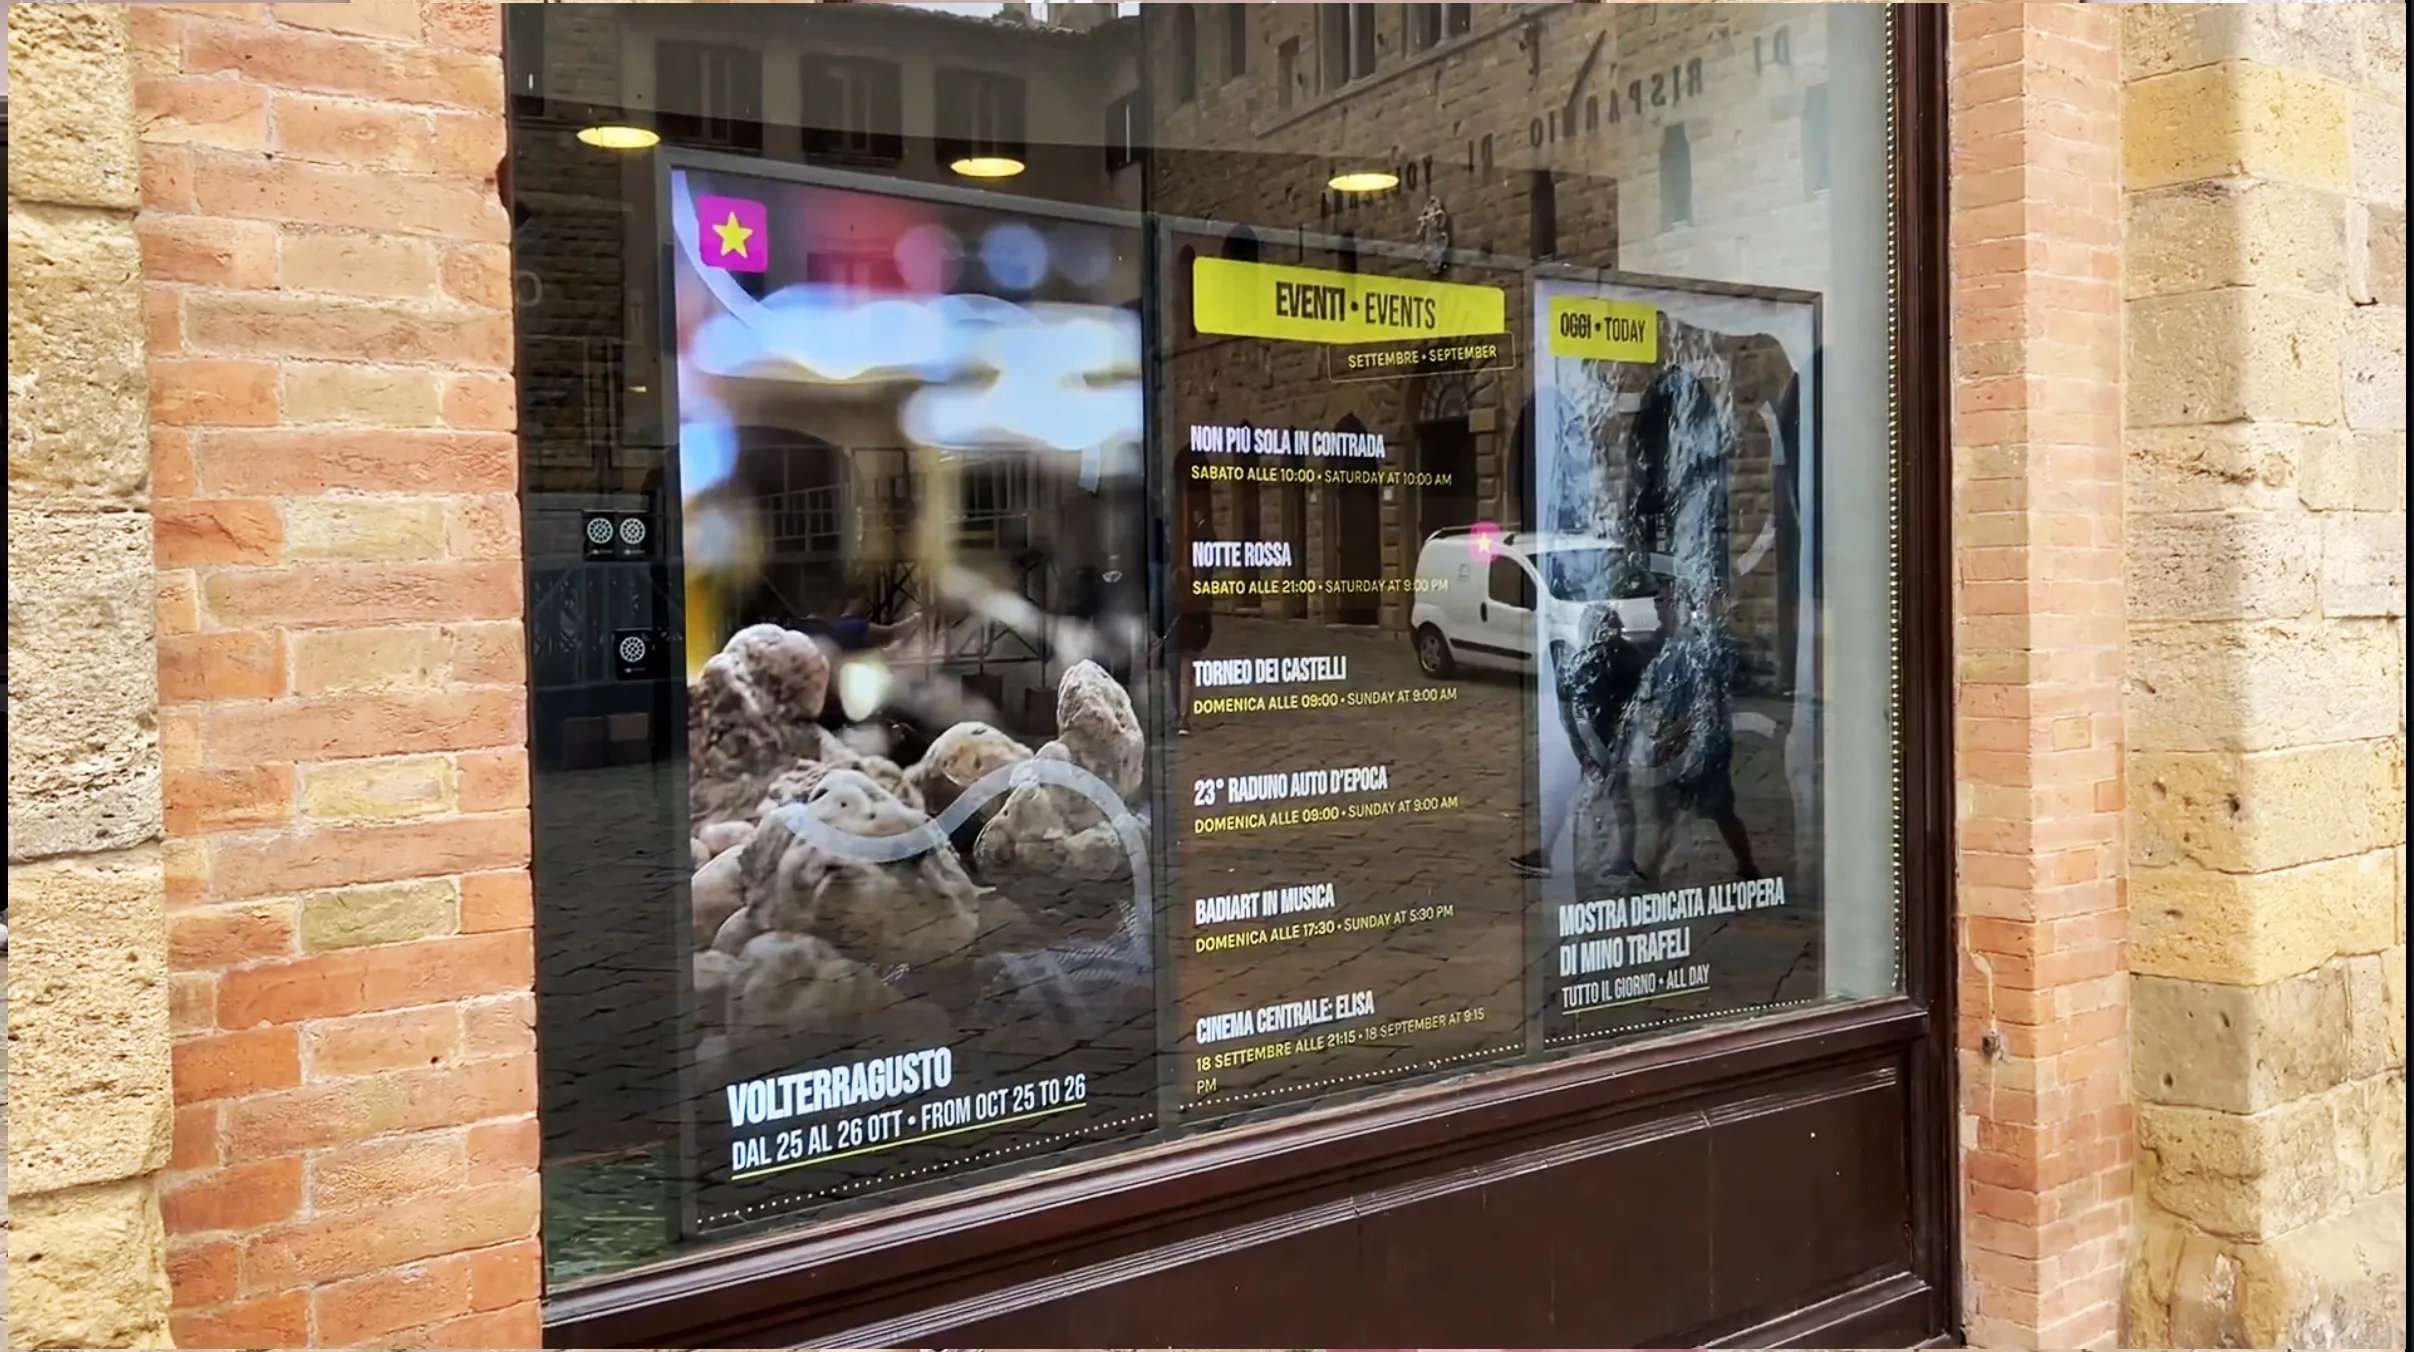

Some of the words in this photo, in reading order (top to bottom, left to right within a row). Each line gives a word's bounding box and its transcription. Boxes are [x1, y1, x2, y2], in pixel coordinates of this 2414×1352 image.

[1276, 281, 1346, 322] EVENTI
[1365, 292, 1436, 329] EVENTS
[1560, 312, 1591, 338] OGGI
[1604, 317, 1646, 344] TODAY
[1348, 351, 1419, 369] SETTEMBRE
[1429, 345, 1497, 362] SEPTEMBER
[1191, 426, 1224, 452] NON
[1226, 426, 1250, 453] PIÙ
[1253, 429, 1291, 454] SOLA
[1294, 431, 1309, 455] IN
[1312, 431, 1385, 458] CONTRADA
[1191, 466, 1244, 481] SABATO
[1247, 468, 1278, 482] ALLE
[1280, 468, 1315, 482] 10:00
[1324, 469, 1385, 484] SATURDAY
[1386, 472, 1401, 485] AT
[1403, 472, 1432, 486] 10:00
[1434, 473, 1452, 486] AM
[1192, 541, 1242, 568] NOTTE
[1244, 542, 1292, 567] ROSSA
[1192, 581, 1245, 595] SABATO
[1249, 580, 1279, 594] ALLE
[1282, 580, 1316, 594] 21:00
[1325, 579, 1387, 593] SATURDAY
[1388, 579, 1402, 592] AT
[1403, 579, 1429, 592] 9:00
[1432, 579, 1448, 592] PM
[1192, 659, 1252, 687] TORNEO
[1255, 659, 1279, 684] DEI
[1282, 656, 1346, 682] CASTELLI
[1194, 697, 1266, 714] DOMENICA
[1268, 695, 1298, 710] ALLE
[1301, 693, 1338, 708] 09:00
[1347, 691, 1395, 706] SUNDAY
[1398, 690, 1410, 703] AT
[1412, 689, 1437, 702] 9:00
[1439, 688, 1457, 701] AM
[1194, 778, 1224, 806] 23°
[1228, 774, 1288, 803] RADUNO
[1290, 770, 1327, 798] AUTO
[1330, 766, 1388, 794] D'EPOCA
[1195, 813, 1266, 834] DOMENICA
[1269, 810, 1299, 826] ALLE
[1302, 807, 1339, 822] 09:00
[1348, 803, 1395, 818] SUNDAY
[1398, 801, 1410, 813] AT
[1414, 798, 1438, 812] 9:00
[1440, 796, 1458, 809] AM
[1195, 892, 1260, 925] BADIART
[1262, 890, 1278, 915] IN
[1281, 883, 1335, 914] MUSICA
[1559, 896, 1628, 937] MOSTRA
[1631, 887, 1705, 926] DEDICATA
[1196, 931, 1267, 952] DOMENICA
[1270, 925, 1300, 942] ALLE
[1303, 921, 1335, 937] 17:30
[1344, 914, 1390, 932] SUNDAY
[1394, 911, 1406, 924] AT
[1409, 907, 1433, 922] 5:30
[1436, 905, 1453, 918] PM
[1560, 946, 1577, 977] DI
[1581, 937, 1623, 973] MINO
[1626, 927, 1690, 965] TRAFELI
[1562, 984, 1598, 1008] TUTTO
[1601, 981, 1613, 1001] IL
[1614, 972, 1656, 999] GIORNO
[1667, 968, 1688, 989] ALL
[1690, 964, 1710, 985] DAY
[1196, 1010, 1253, 1044] CINEMA
[1257, 998, 1332, 1034] CENTRALE:
[1336, 991, 1374, 1020] ELISA
[1196, 1057, 1210, 1072] 18
[1214, 1044, 1292, 1068] SETTEMBRE
[1295, 1037, 1325, 1053] ALLE
[1328, 1031, 1356, 1047] 21:15
[1365, 1027, 1377, 1040] 18
[1380, 1014, 1446, 1037] SEPTEMBER
[1449, 1012, 1462, 1024] AT
[1464, 1008, 1484, 1023] 9:15
[727, 1046, 952, 1127] VOLTERRAGUSTO
[1196, 1078, 1217, 1094] PM
[732, 1139, 771, 1171] DAL
[777, 1134, 803, 1162] 25
[808, 1127, 832, 1155] AL
[838, 1119, 862, 1148] 26
[868, 1110, 903, 1143] OTT
[921, 1097, 971, 1132] FROM
[975, 1089, 1008, 1120] OCT
[1012, 1082, 1035, 1111] 25
[1039, 1077, 1059, 1105] TO
[1064, 1073, 1086, 1101] 26
